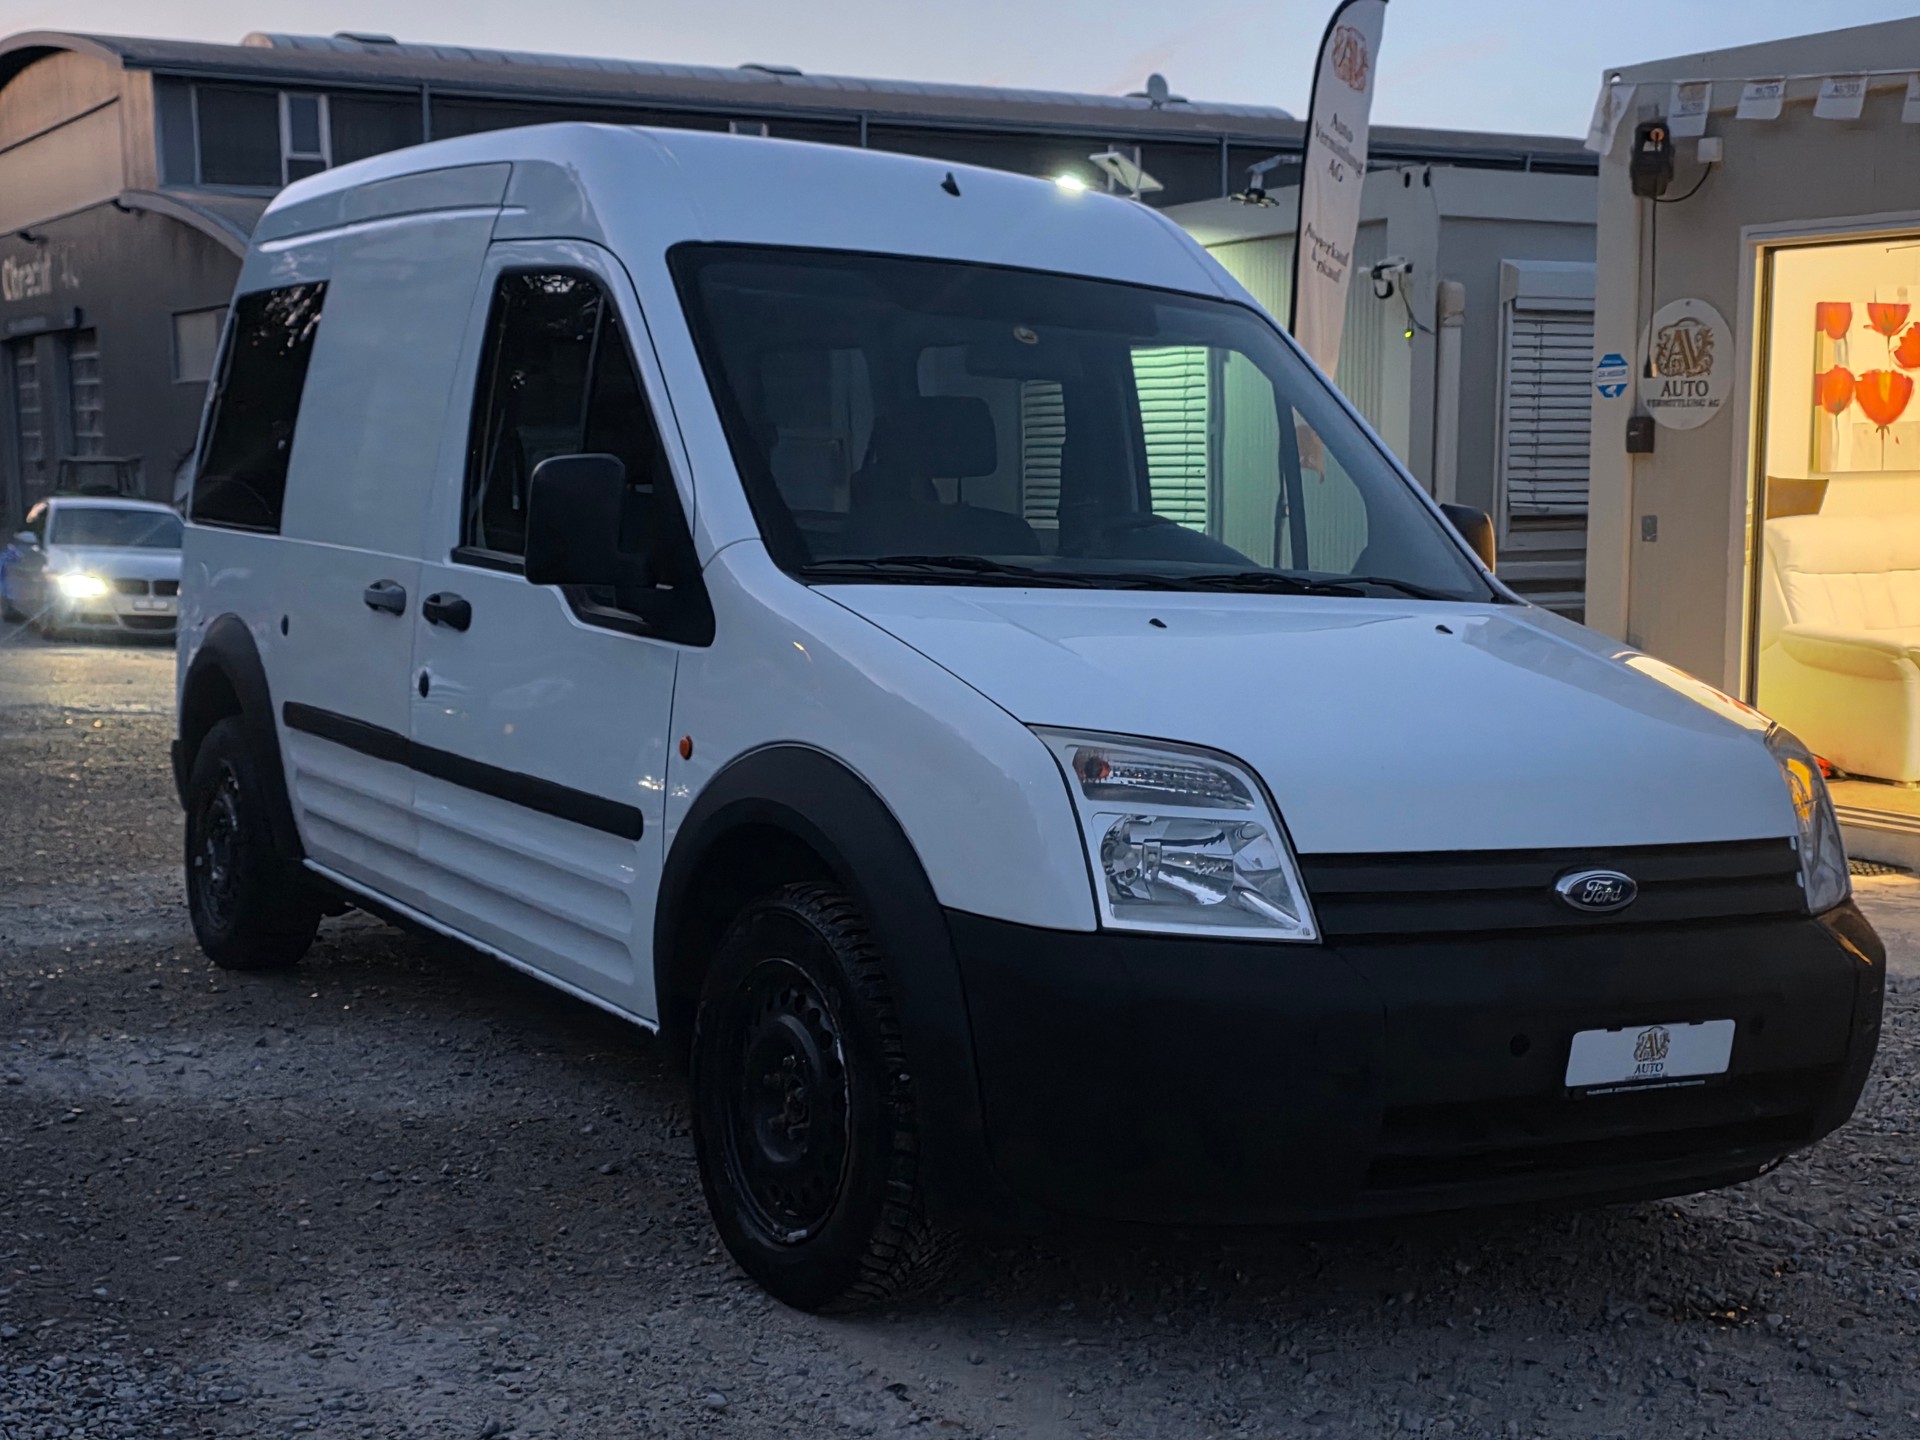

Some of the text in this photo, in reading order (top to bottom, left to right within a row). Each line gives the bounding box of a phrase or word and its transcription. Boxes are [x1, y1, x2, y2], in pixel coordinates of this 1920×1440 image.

[1660, 381, 1709, 397] AUTO
[1582, 879, 1622, 903] Ford
[1634, 1062, 1664, 1075] AUTO
